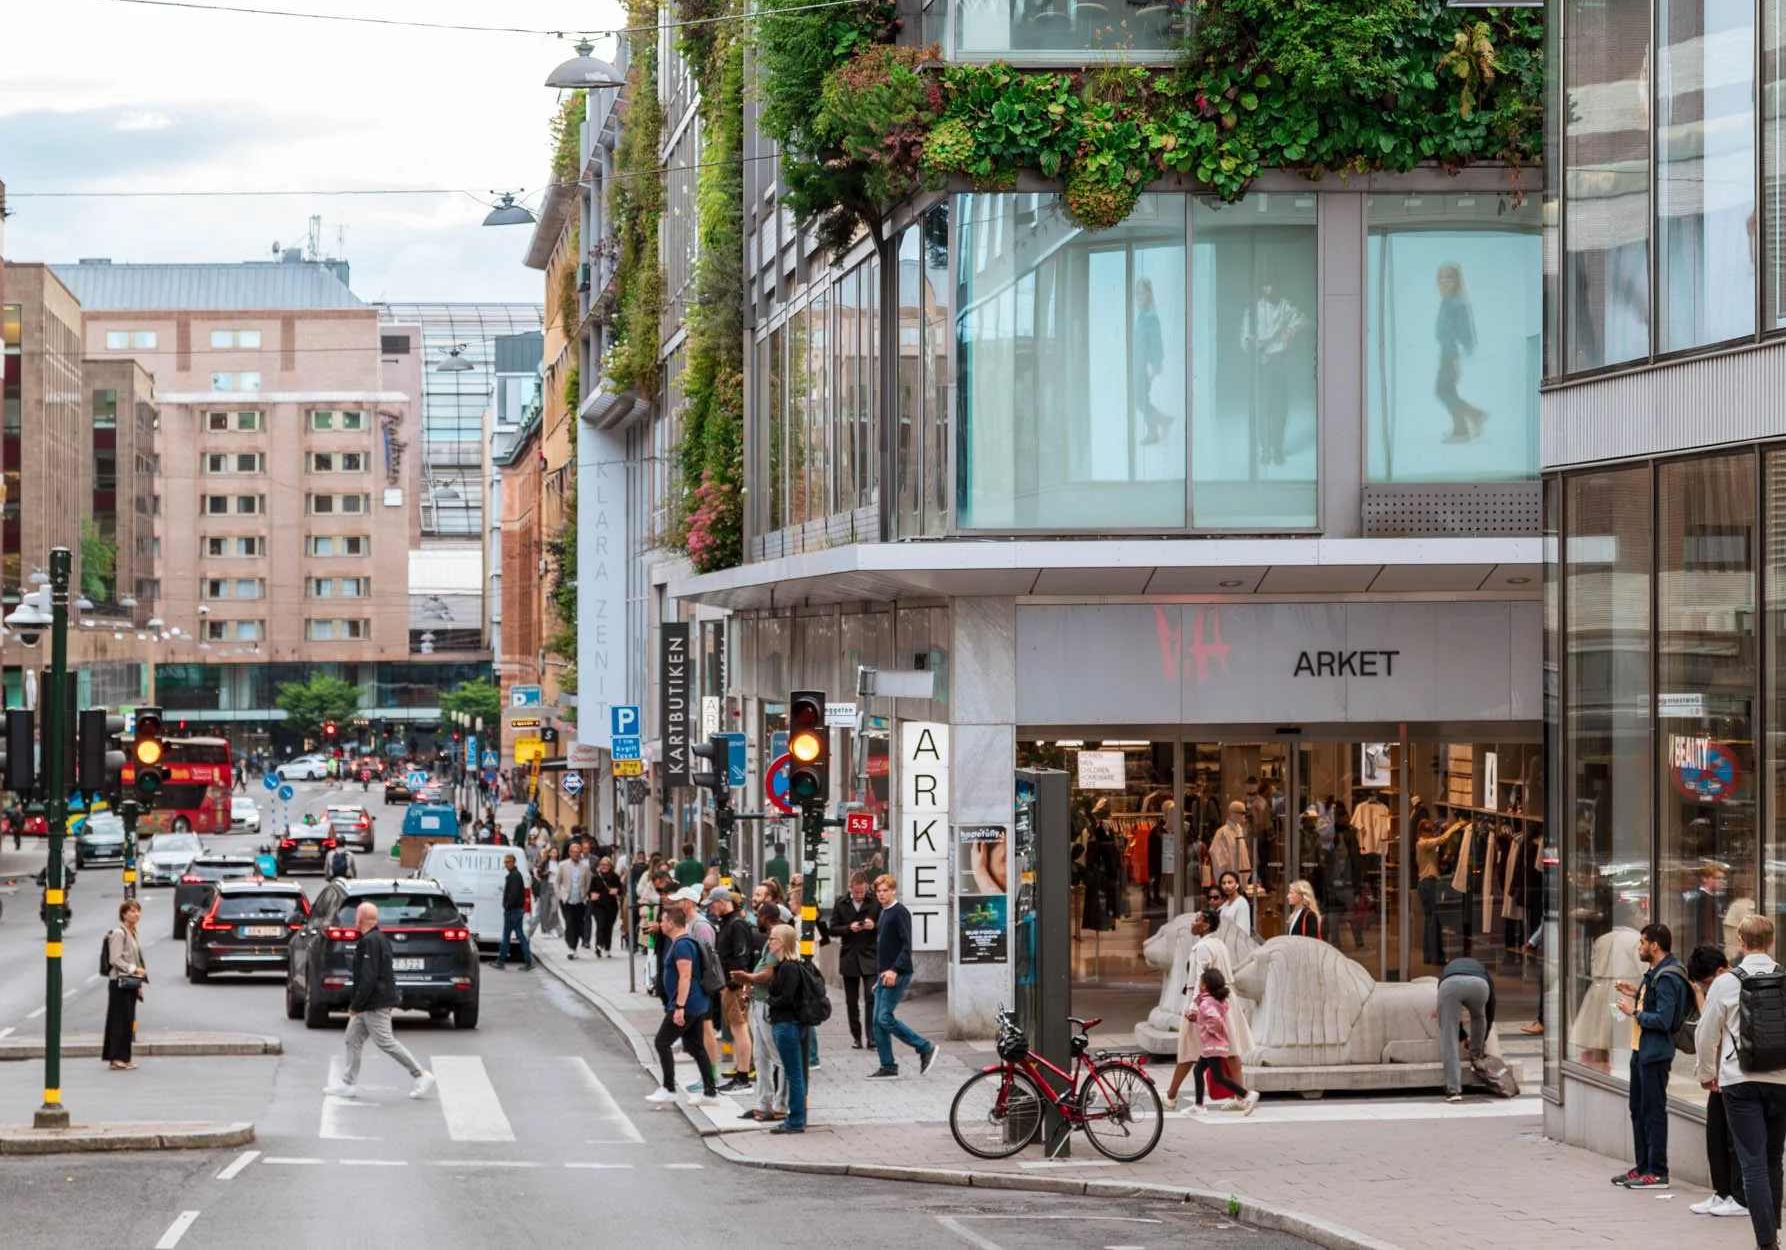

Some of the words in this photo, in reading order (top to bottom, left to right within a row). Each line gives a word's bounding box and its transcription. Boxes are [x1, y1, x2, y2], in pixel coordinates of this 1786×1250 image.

[595, 461, 609, 581] KLARA
[595, 600, 609, 720] ZENIT
[668, 637, 684, 774] KARTBUTIKEN
[1293, 651, 1400, 677] ARKET
[618, 708, 635, 734] P
[912, 728, 940, 945] ARKET
